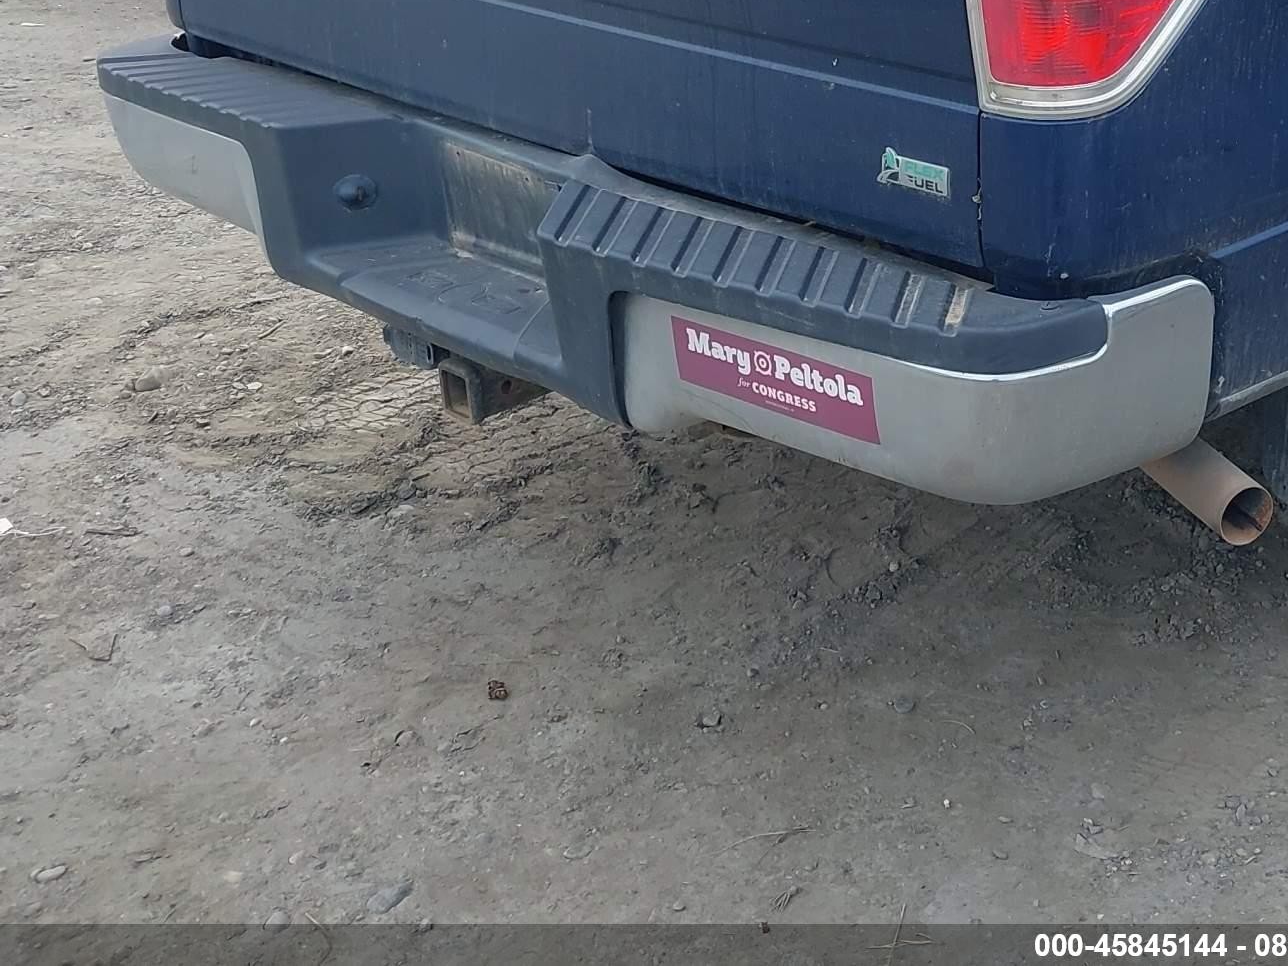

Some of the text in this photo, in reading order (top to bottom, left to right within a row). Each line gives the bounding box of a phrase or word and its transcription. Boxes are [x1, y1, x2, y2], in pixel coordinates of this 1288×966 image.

[686, 327, 863, 406] Mary Peltola
[737, 377, 750, 388] for
[752, 382, 817, 412] CONGRESS
